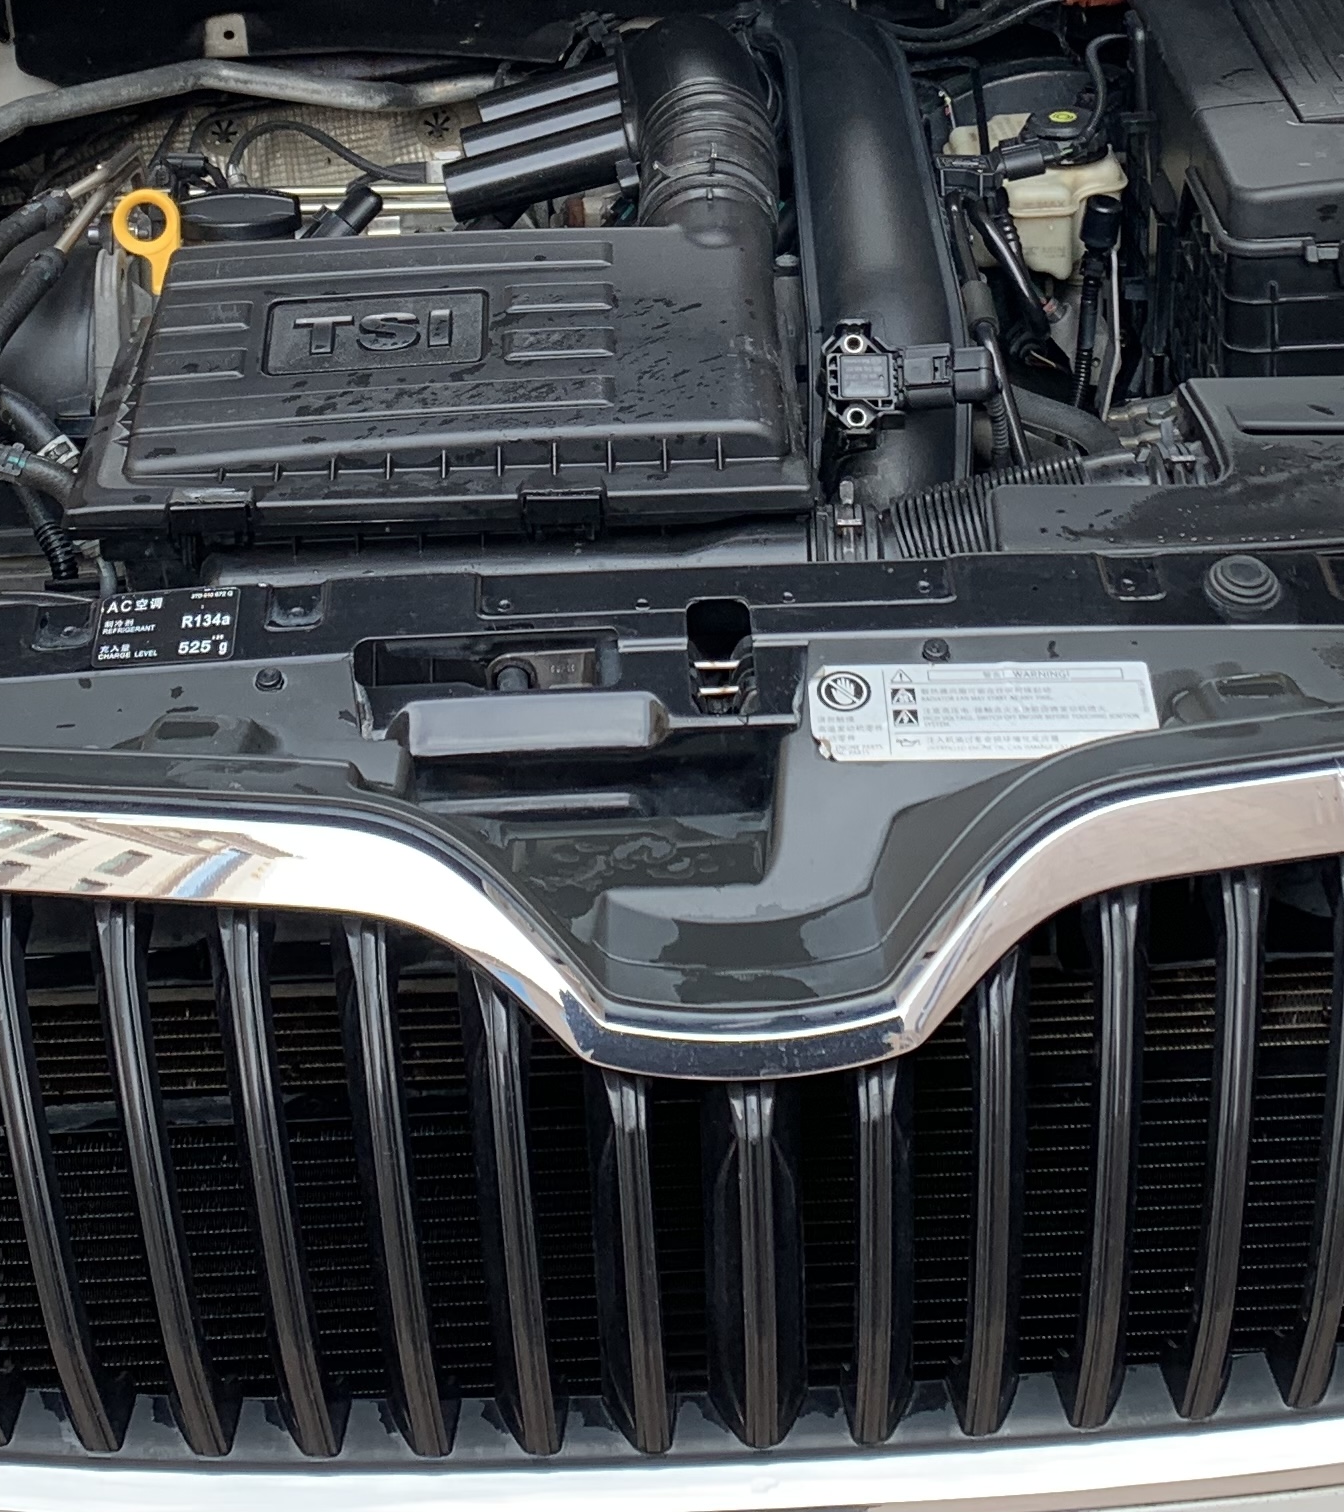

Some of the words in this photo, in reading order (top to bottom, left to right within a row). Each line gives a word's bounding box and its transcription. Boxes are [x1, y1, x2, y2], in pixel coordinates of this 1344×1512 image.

[293, 309, 454, 355] TSI
[181, 613, 231, 629] R134a
[102, 624, 156, 635] REFRIGERANT
[178, 640, 212, 655] 525
[218, 641, 228, 655] g
[97, 651, 131, 660] CHARGE
[134, 649, 158, 658] LEVEL
[1012, 670, 1070, 679] WARNING!
